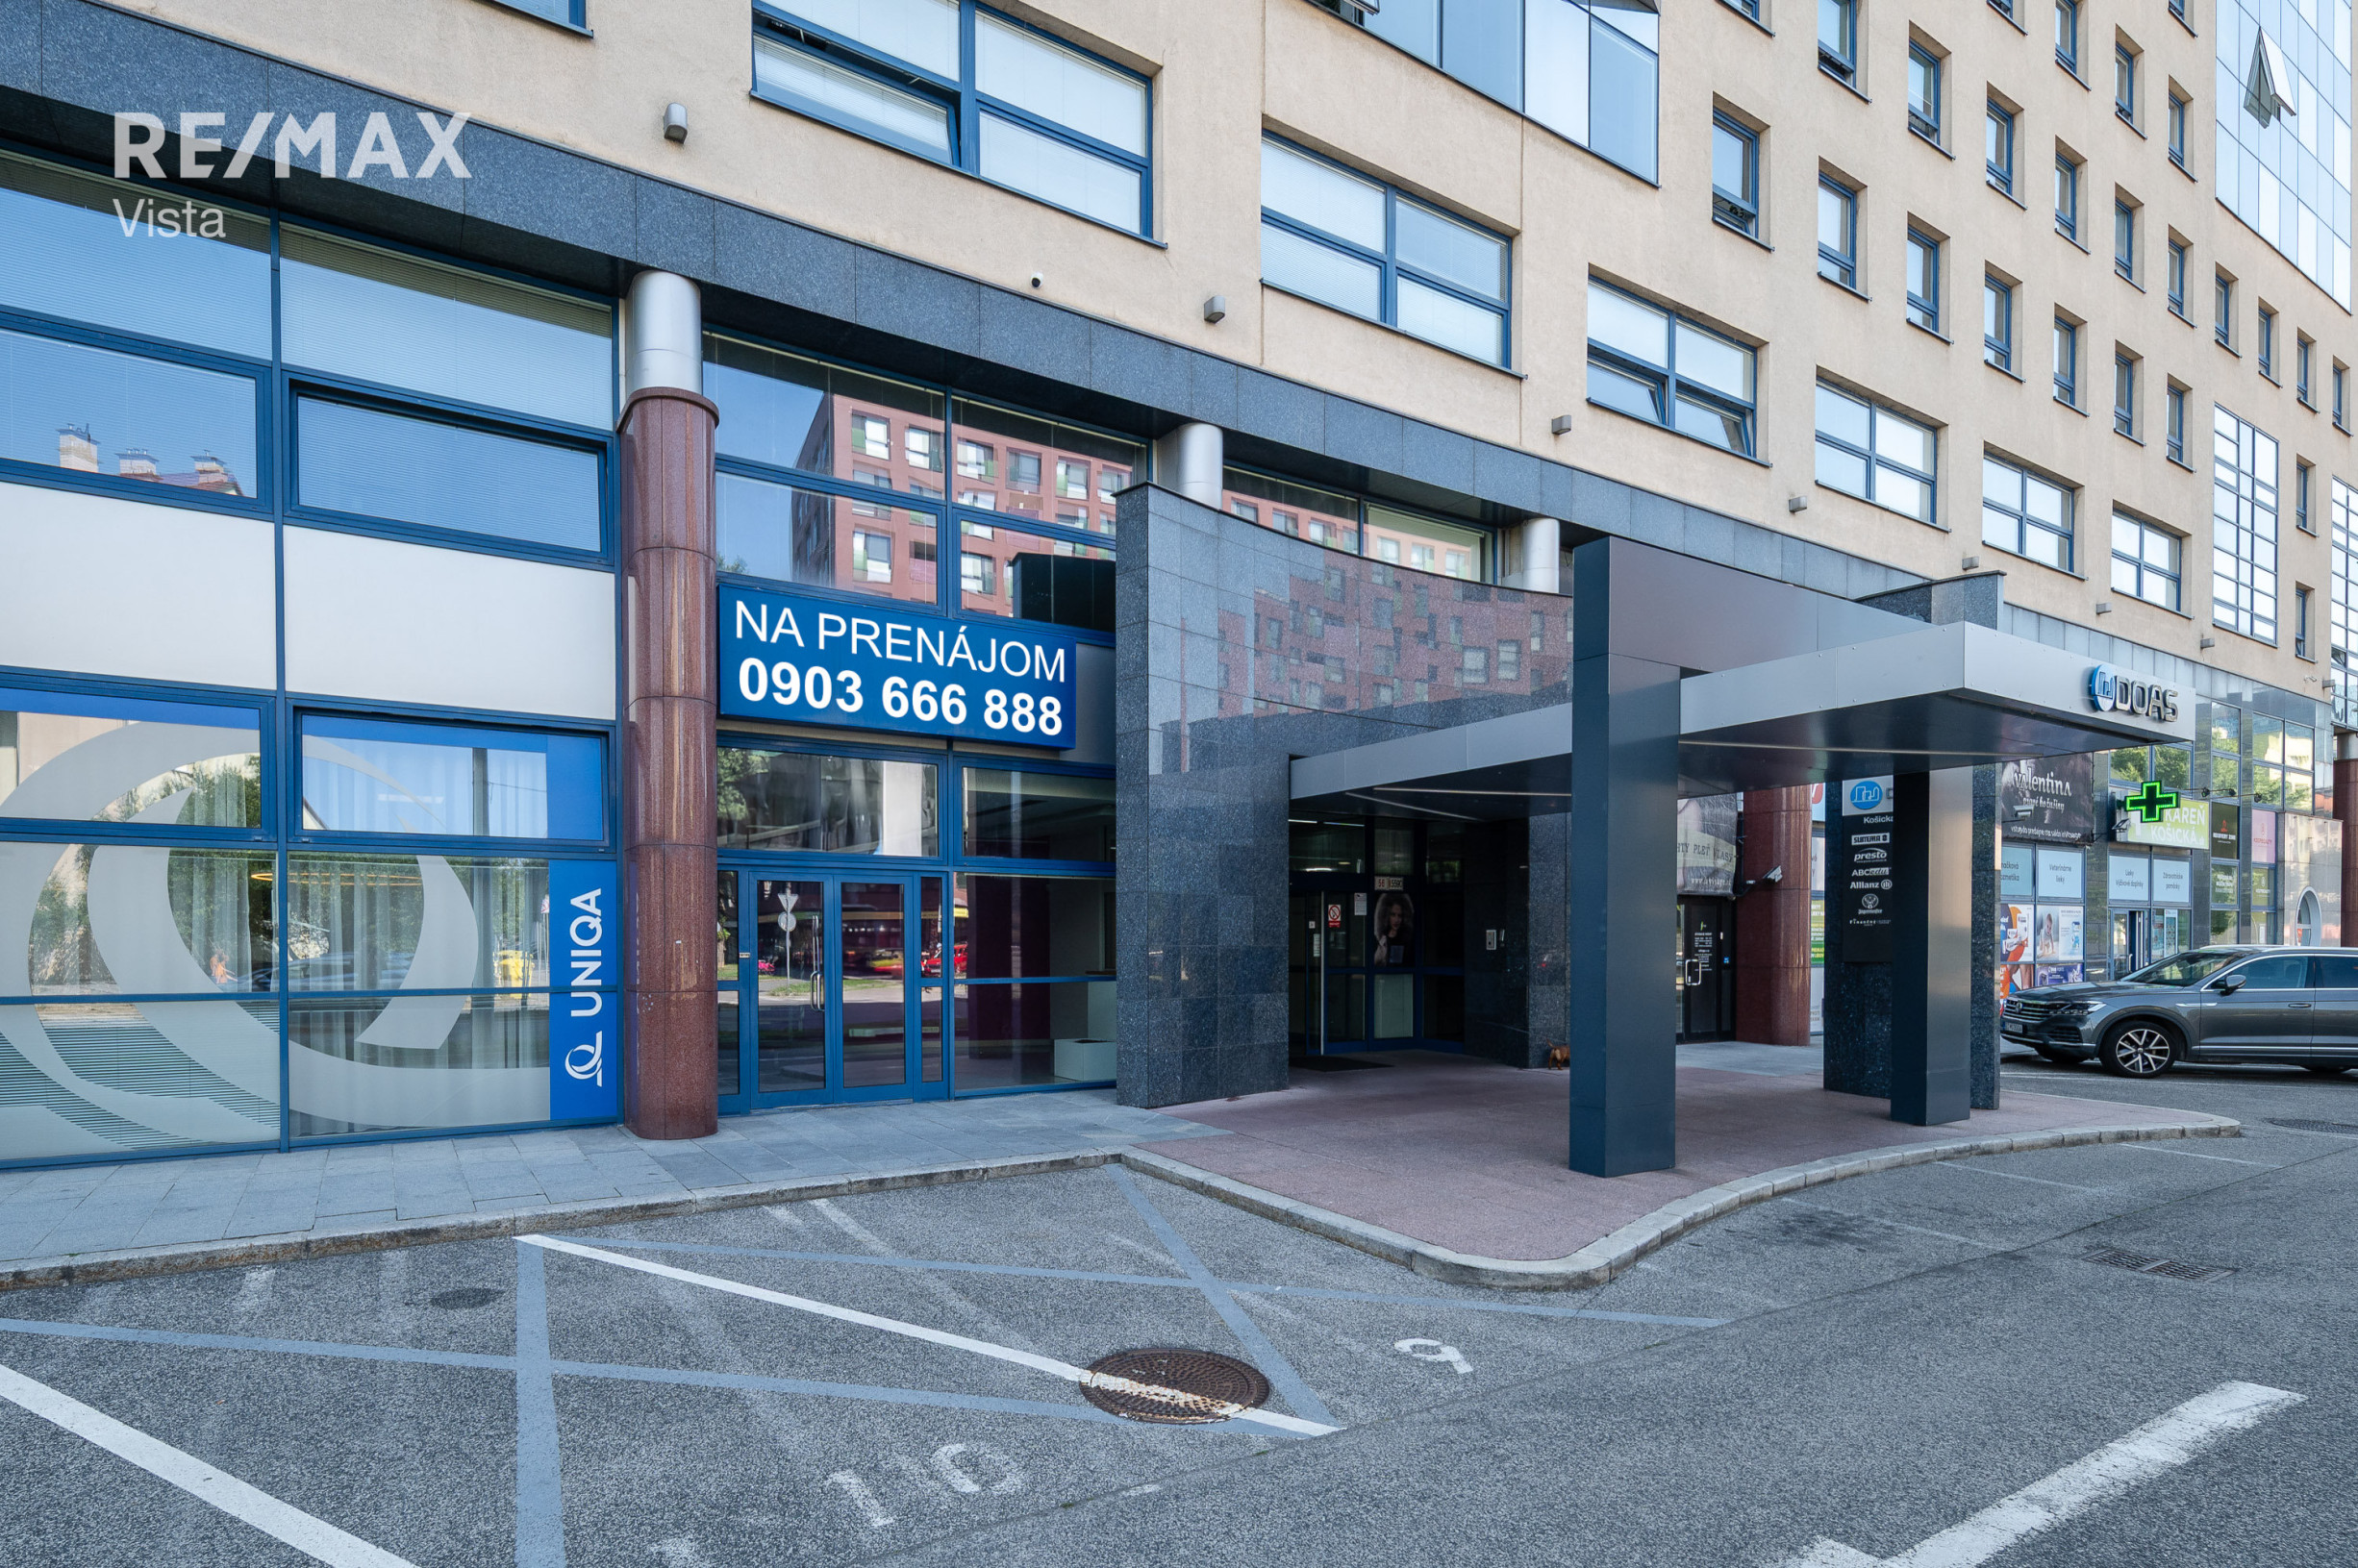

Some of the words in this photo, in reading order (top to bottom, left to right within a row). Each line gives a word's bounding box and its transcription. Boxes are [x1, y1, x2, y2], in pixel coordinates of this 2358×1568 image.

[736, 600, 805, 648] NA
[817, 612, 1066, 684] PRENÁJOM
[739, 657, 864, 713] 0903
[882, 675, 967, 725] 666
[984, 688, 1063, 736] 888
[2115, 674, 2179, 722] DOAS
[1849, 881, 1880, 889] Allianz
[569, 887, 603, 1017] UNIQA
[1394, 1337, 1473, 1375] 9
